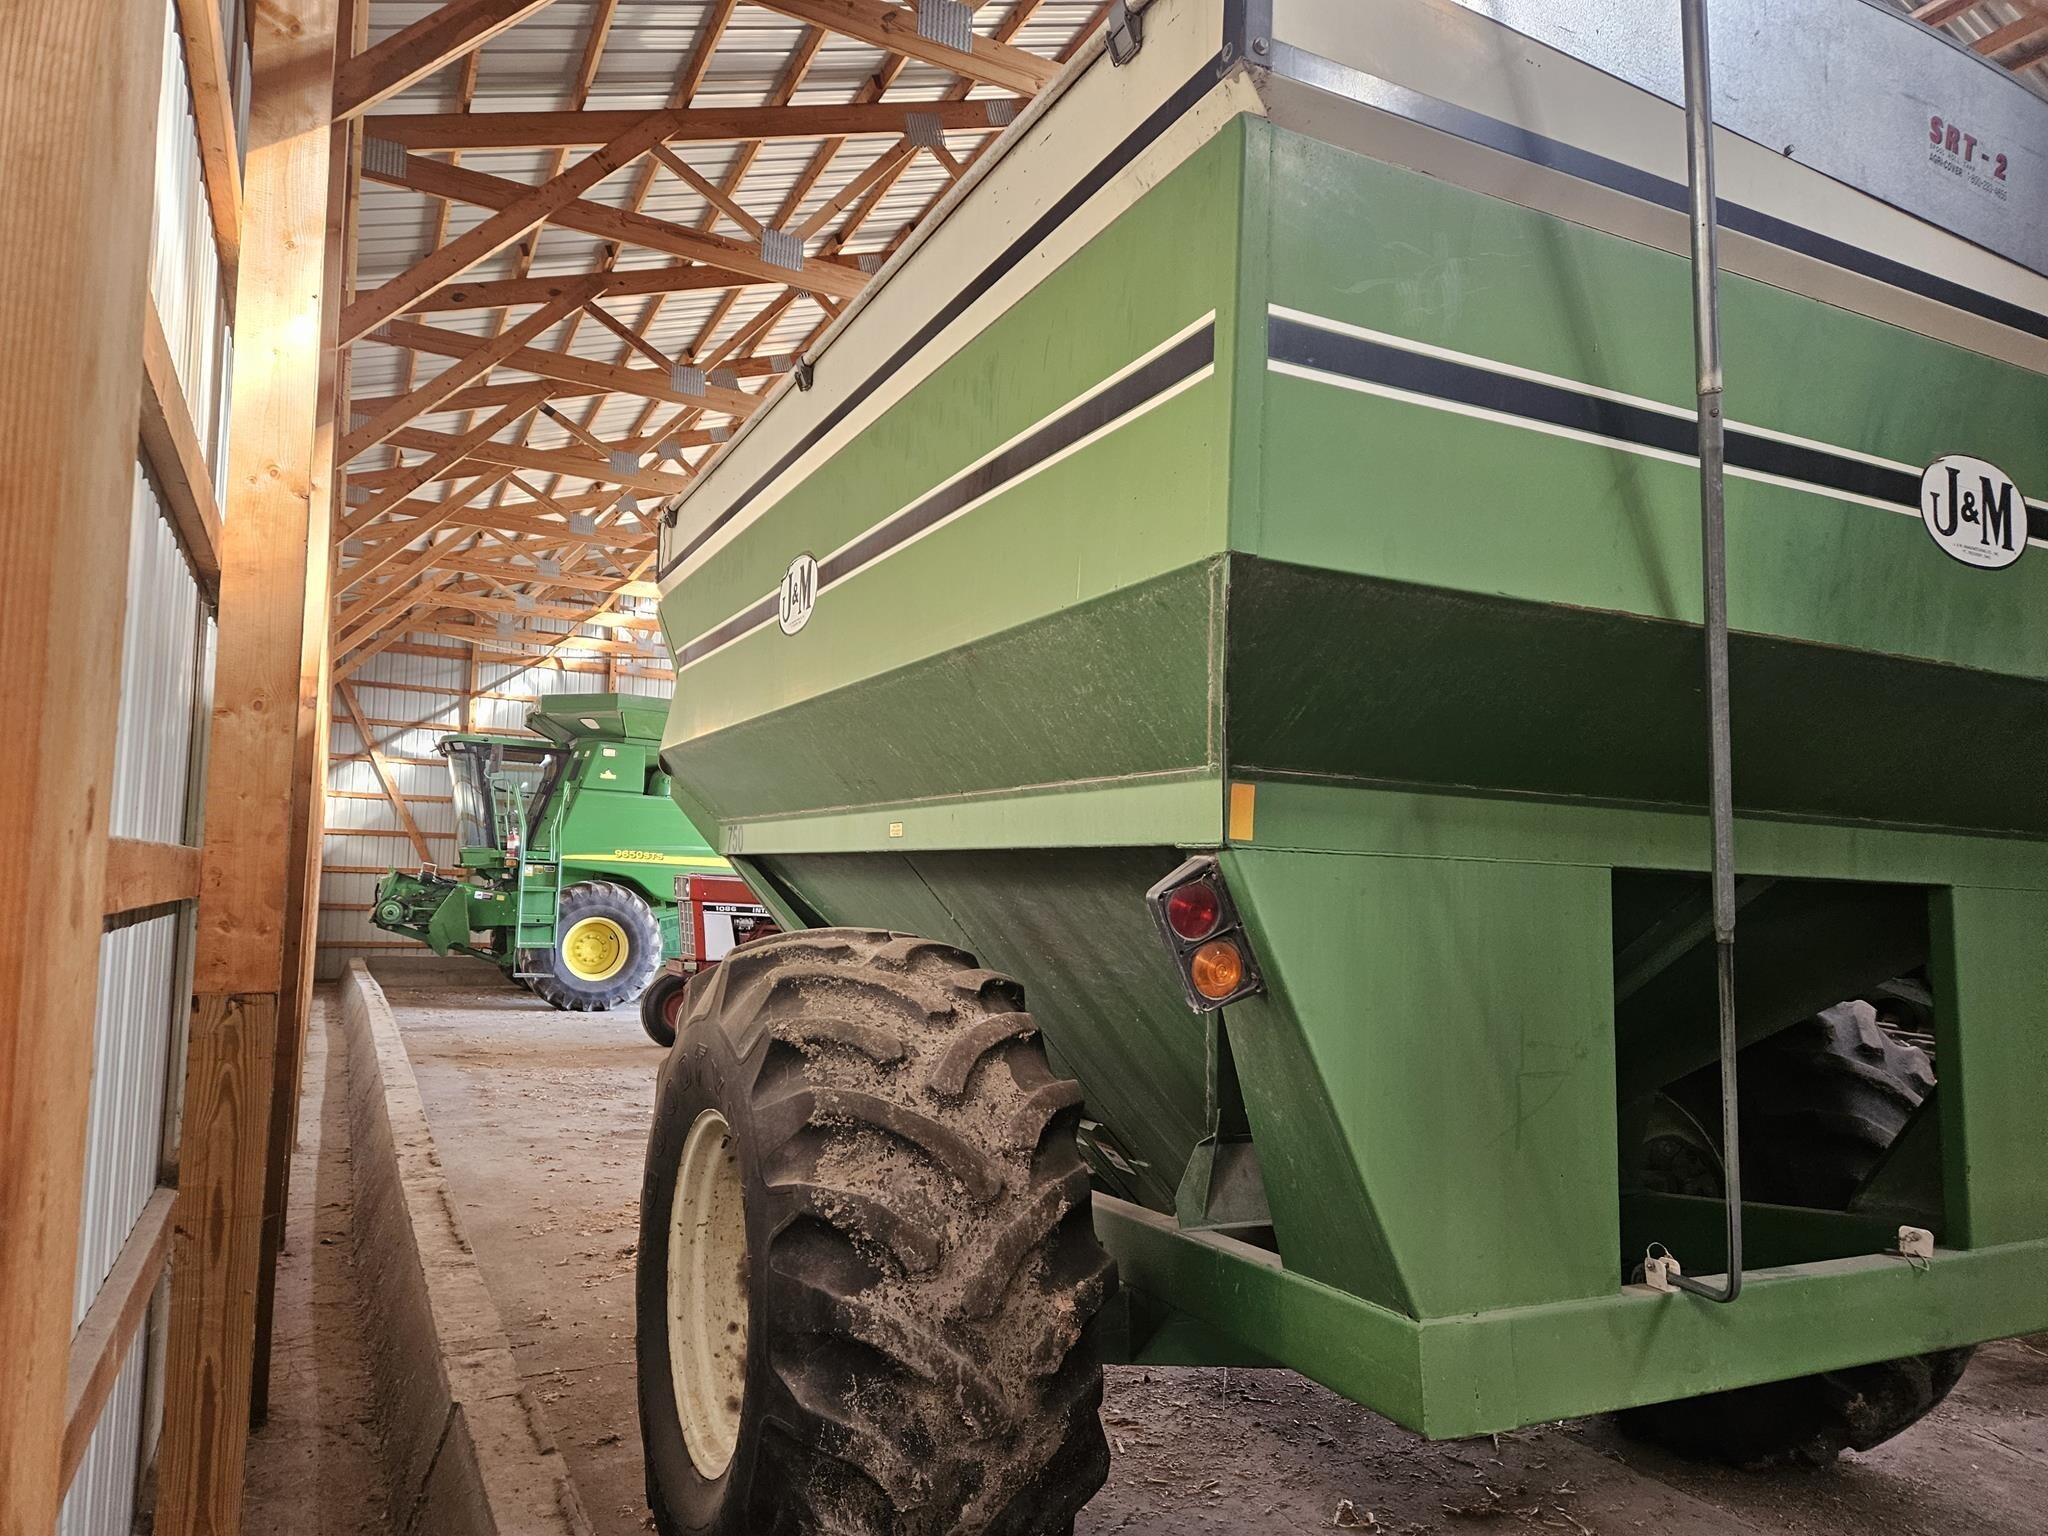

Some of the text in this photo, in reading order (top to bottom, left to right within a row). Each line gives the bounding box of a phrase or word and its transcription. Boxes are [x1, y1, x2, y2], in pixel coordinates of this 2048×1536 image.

[1930, 466, 2015, 551] J&M
[782, 559, 813, 623] J&M
[614, 849, 664, 860] 9650STS
[728, 825, 744, 853] 750
